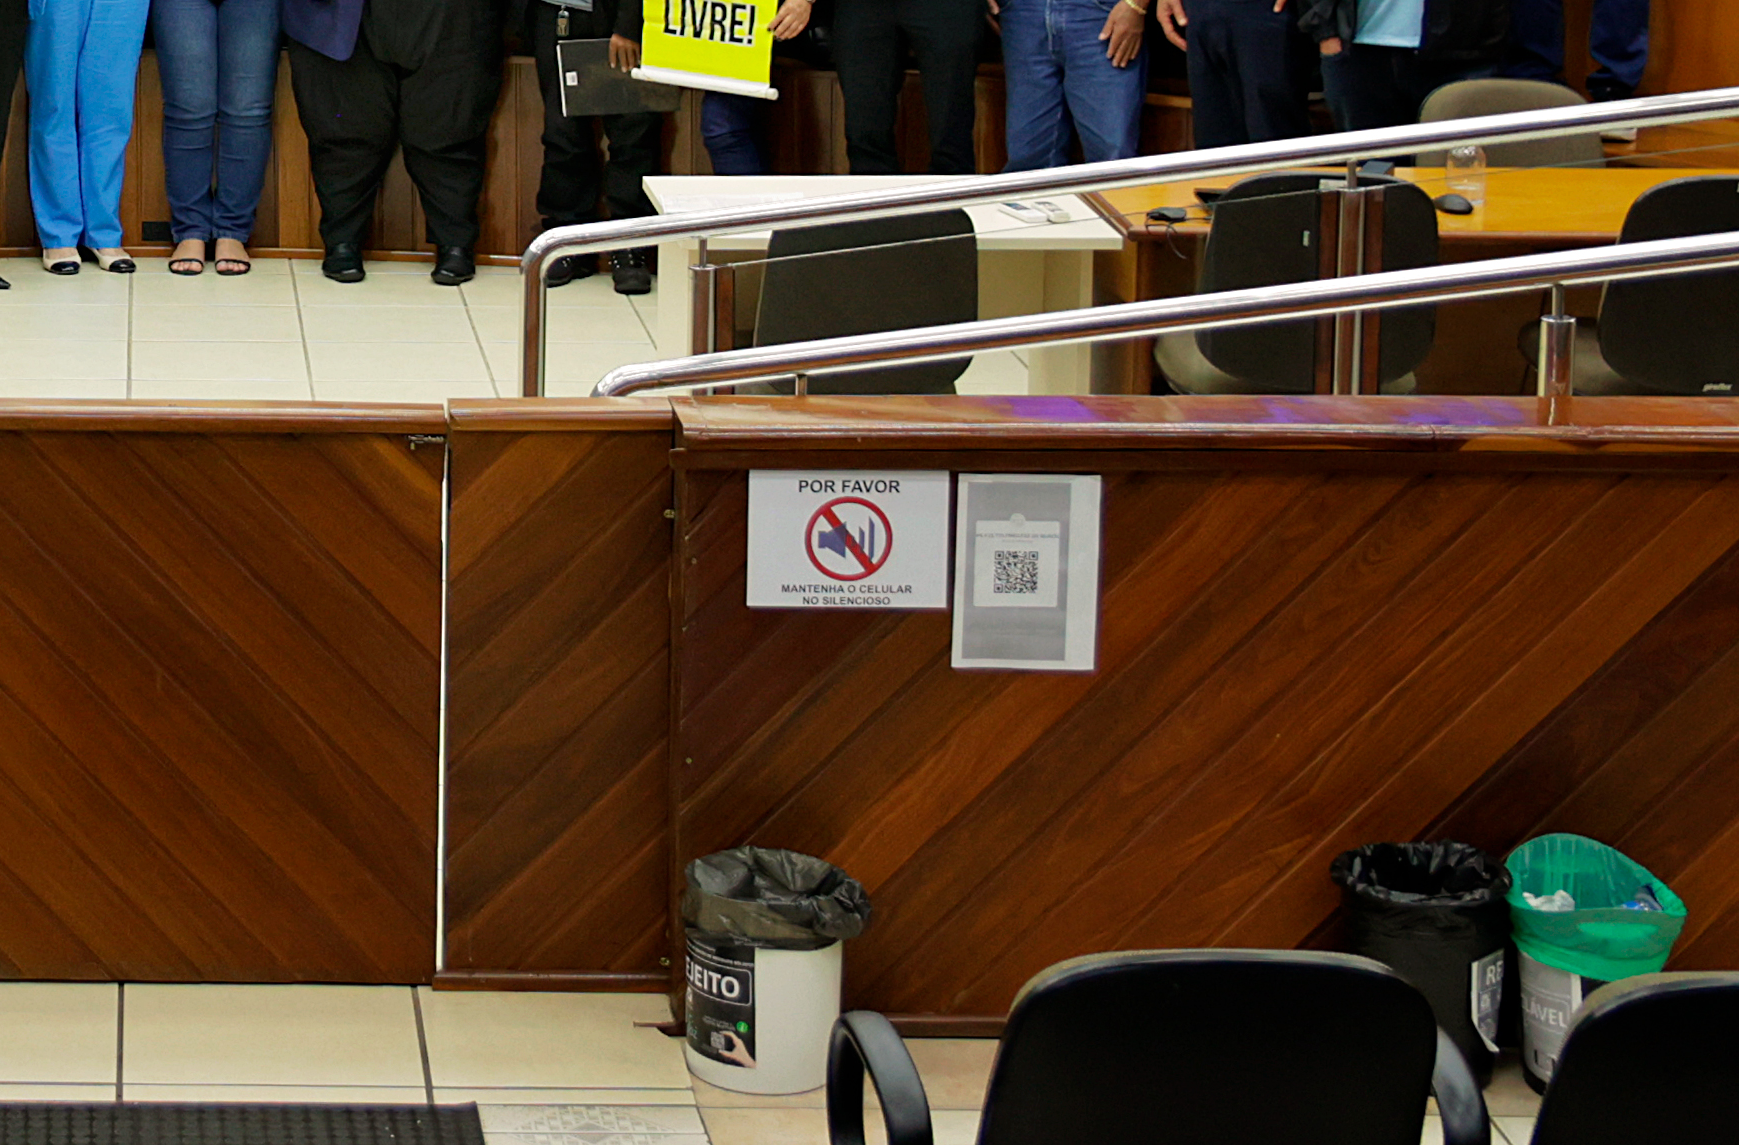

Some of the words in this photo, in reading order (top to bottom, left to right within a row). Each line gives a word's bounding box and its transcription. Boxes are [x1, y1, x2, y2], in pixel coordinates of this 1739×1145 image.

[798, 480, 836, 493] POR
[841, 480, 901, 493] FAVOR
[781, 584, 845, 594] MANTENHA
[847, 584, 856, 594] O
[859, 584, 912, 594] CELULAR
[802, 596, 819, 605] NO
[822, 596, 891, 606] SILENCIOSO
